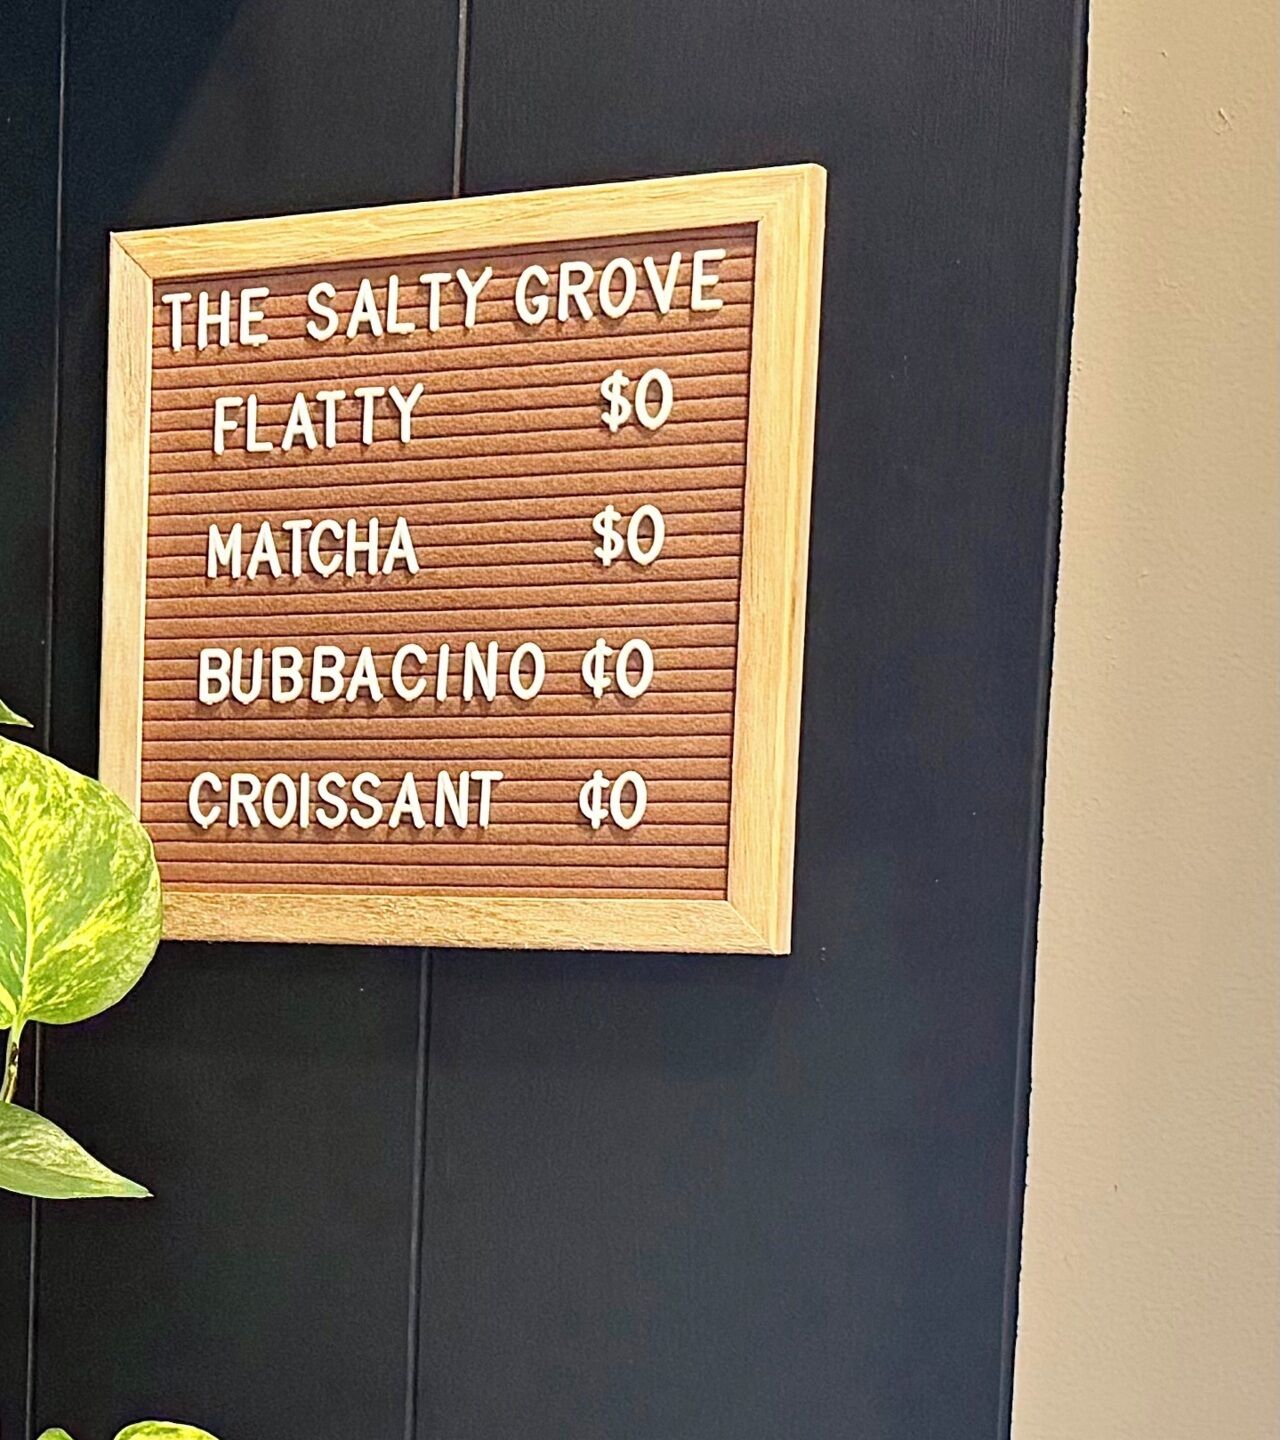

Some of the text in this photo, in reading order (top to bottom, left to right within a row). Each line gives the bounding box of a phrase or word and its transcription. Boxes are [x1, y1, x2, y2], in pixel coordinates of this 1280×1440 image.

[160, 248, 728, 352] THE SALTY GROVE
[212, 367, 675, 456] FLATTY $0
[206, 504, 666, 580] MATCHA $0
[197, 640, 548, 706] BUBBACINO
[187, 769, 505, 830] CROISSANT
